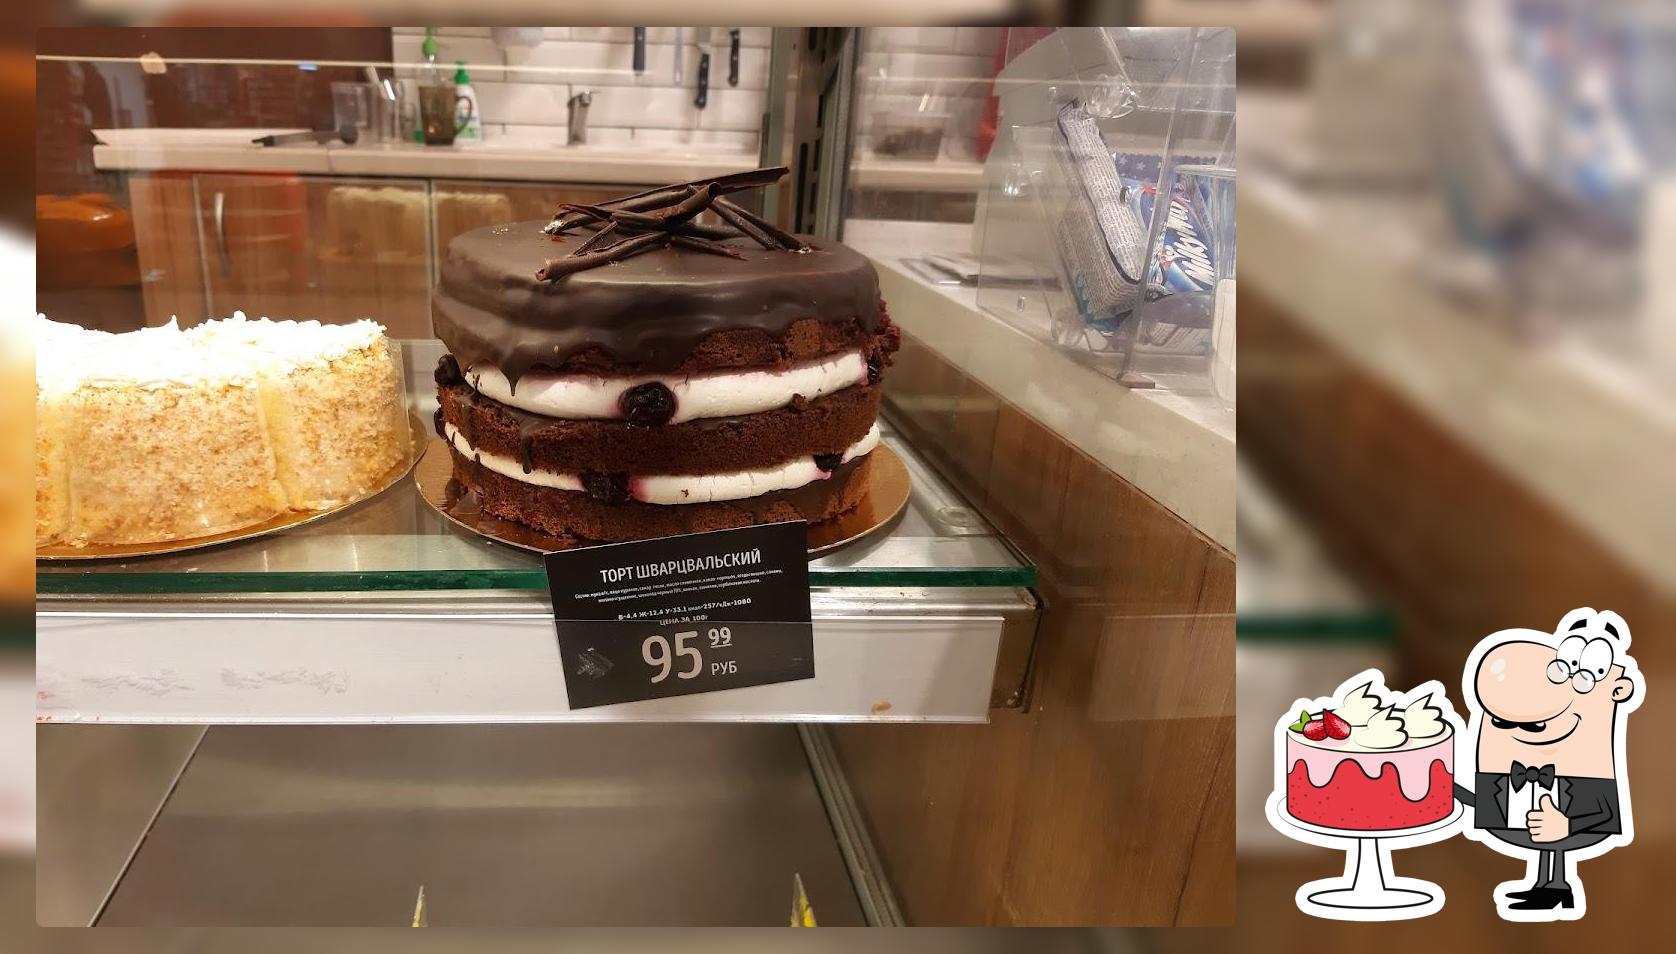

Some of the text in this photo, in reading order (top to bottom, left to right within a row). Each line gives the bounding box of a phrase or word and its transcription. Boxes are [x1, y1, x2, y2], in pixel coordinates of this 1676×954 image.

[600, 566, 633, 583] ТОРТ
[636, 548, 761, 579] ШВАРЦВАЛЬСКИЙ
[660, 617, 680, 626] ЦЕНА
[681, 615, 691, 623] ЗА
[641, 626, 732, 684] 95 99
[711, 660, 738, 676] РУБ
